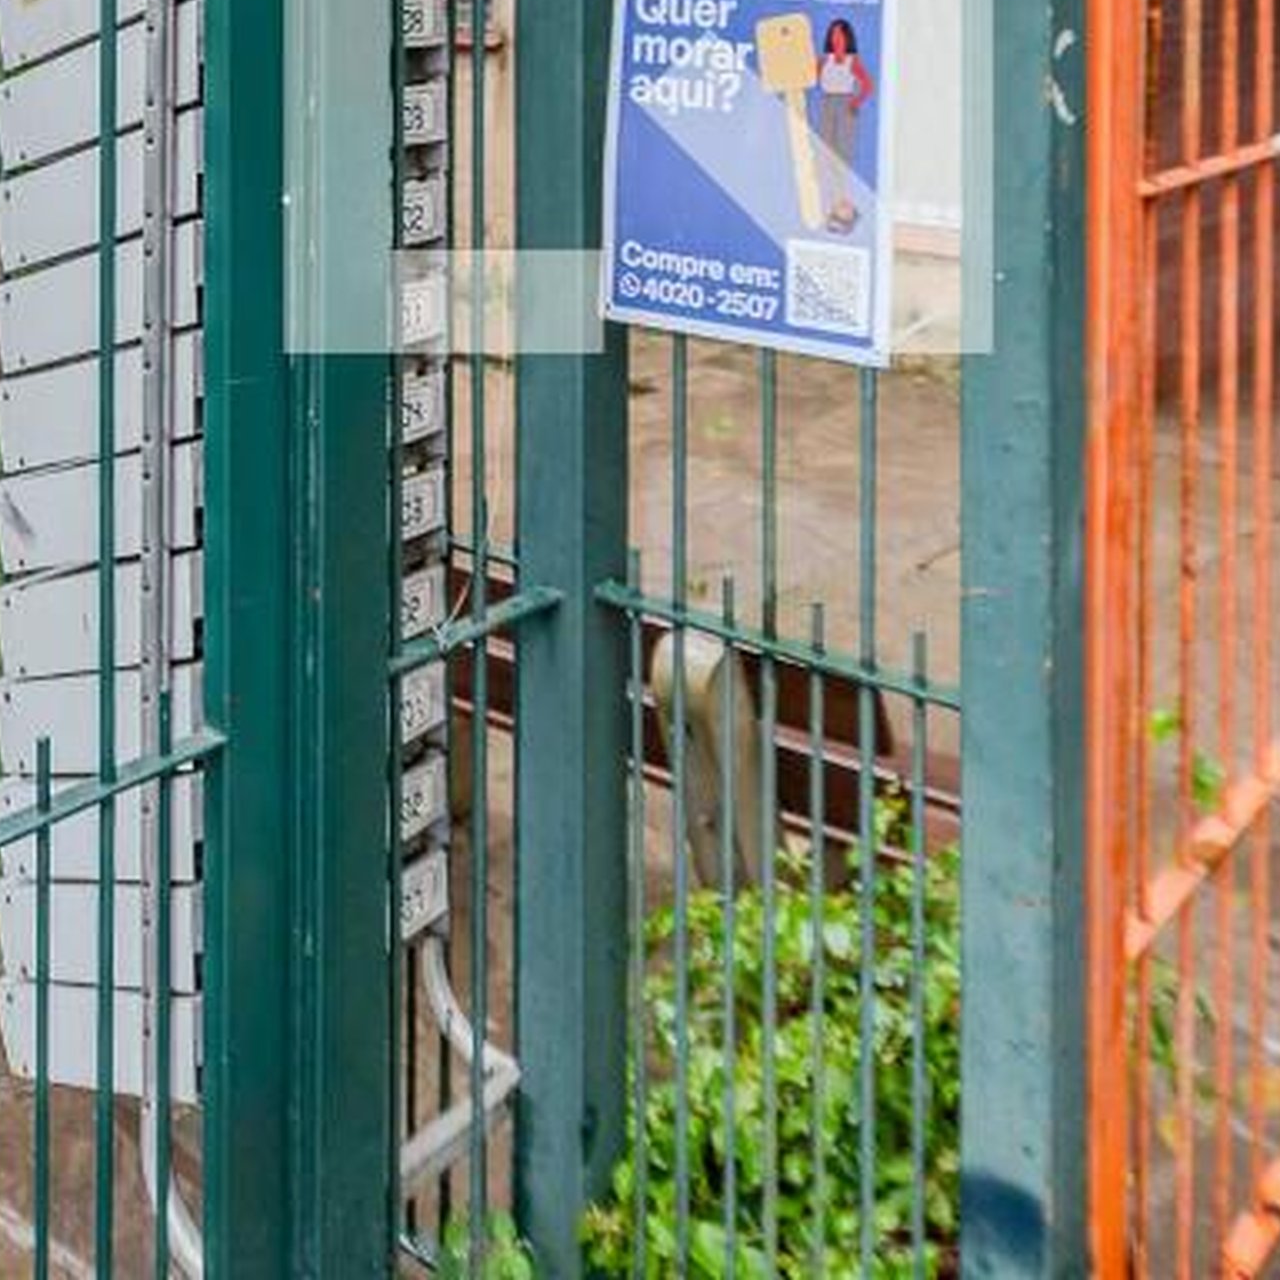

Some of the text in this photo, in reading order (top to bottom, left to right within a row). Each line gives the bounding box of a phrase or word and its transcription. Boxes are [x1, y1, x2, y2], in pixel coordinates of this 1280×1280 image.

[632, 32, 755, 72] morar
[629, 70, 741, 116] aqui?
[621, 240, 781, 291] Compre em:
